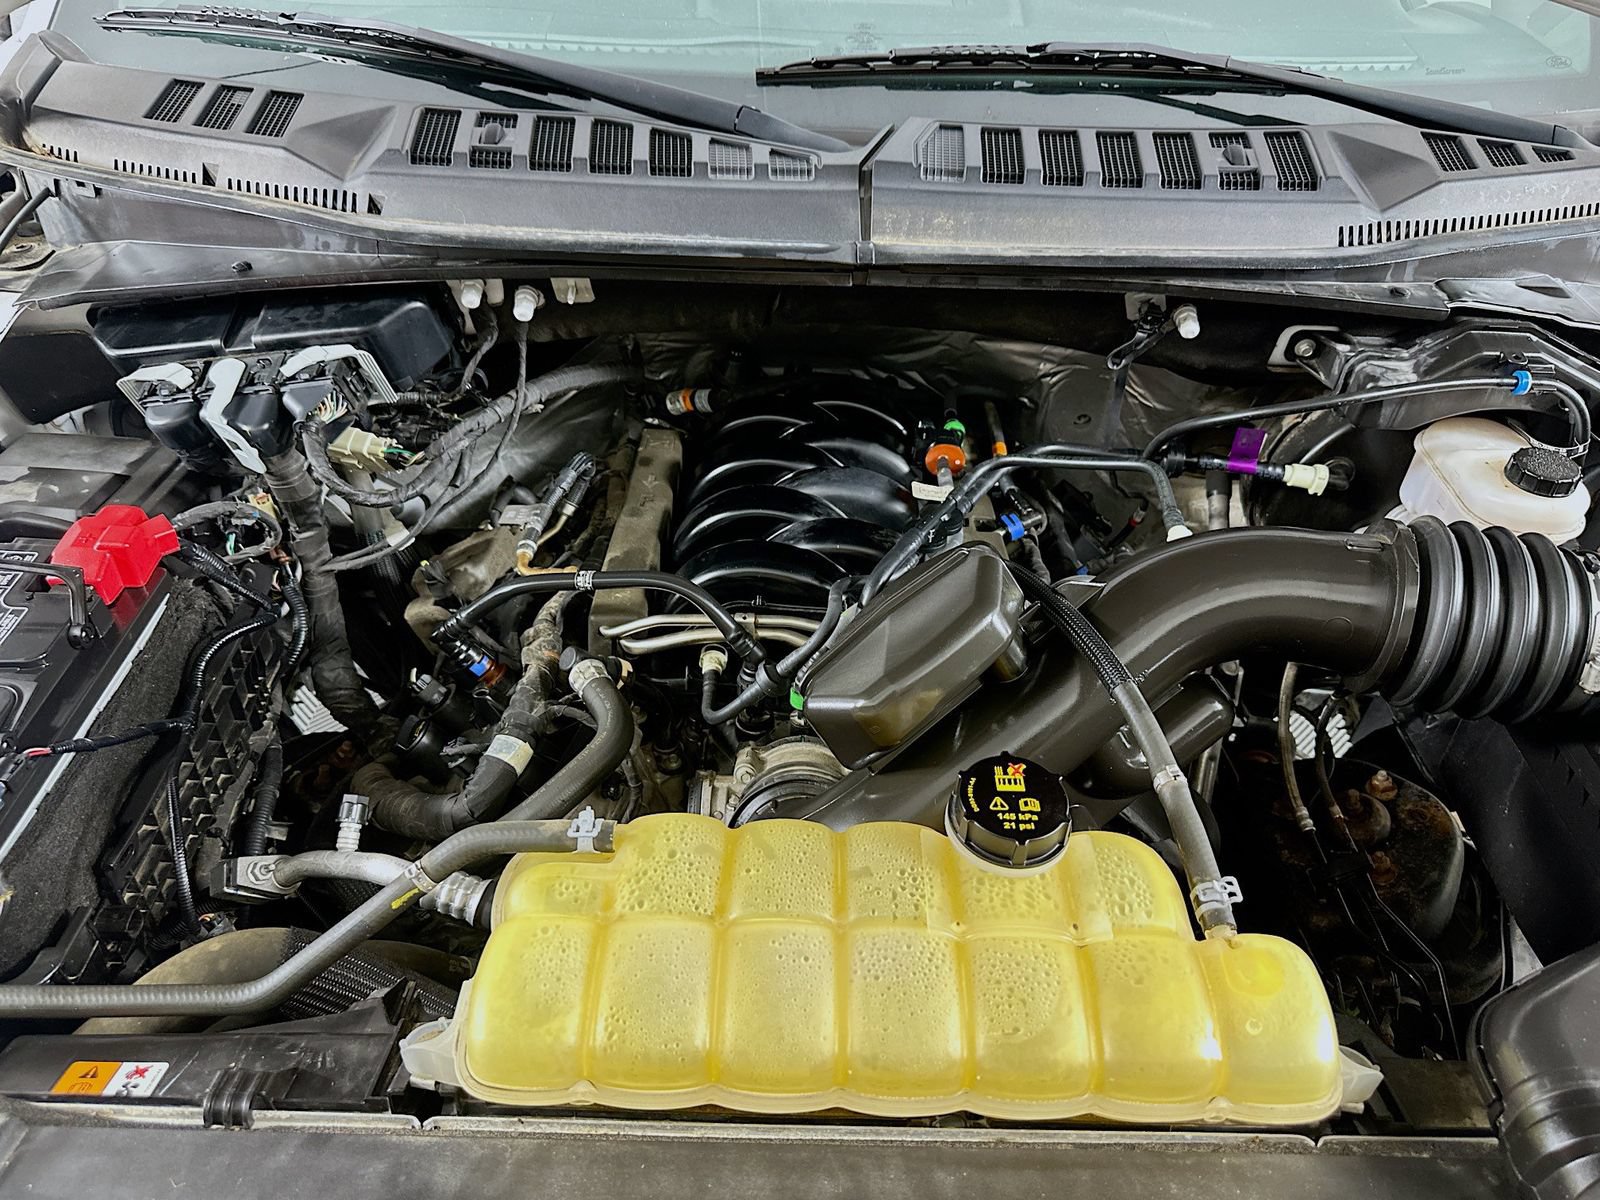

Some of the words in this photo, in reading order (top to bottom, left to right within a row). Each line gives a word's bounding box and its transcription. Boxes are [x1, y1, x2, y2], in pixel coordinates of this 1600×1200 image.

[997, 812, 1016, 820] 145
[1018, 813, 1039, 821] kPa
[1003, 821, 1016, 829] 21
[1019, 822, 1035, 831] psi
